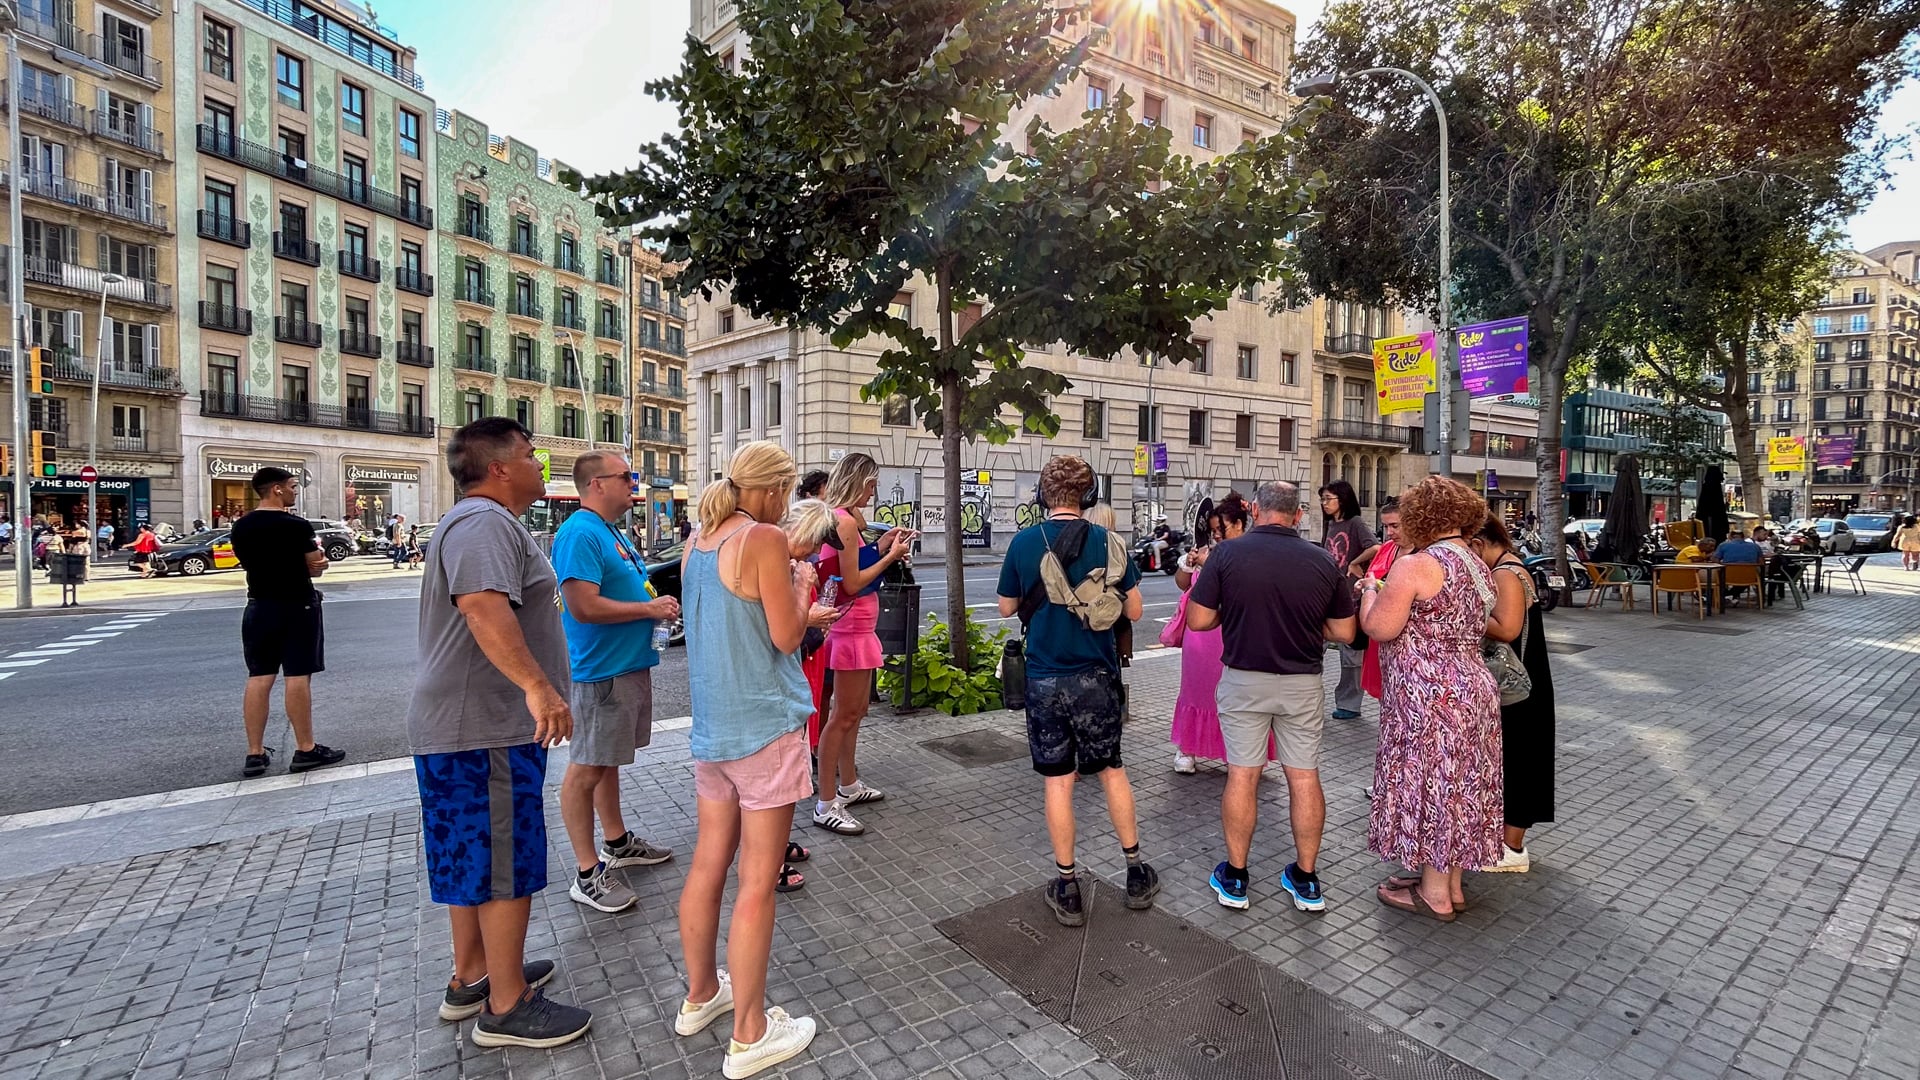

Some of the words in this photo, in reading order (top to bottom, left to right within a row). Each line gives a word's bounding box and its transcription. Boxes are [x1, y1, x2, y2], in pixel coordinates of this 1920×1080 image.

[41, 480, 63, 488] THE
[66, 480, 97, 489] BOD
[100, 481, 130, 489] SHOP
